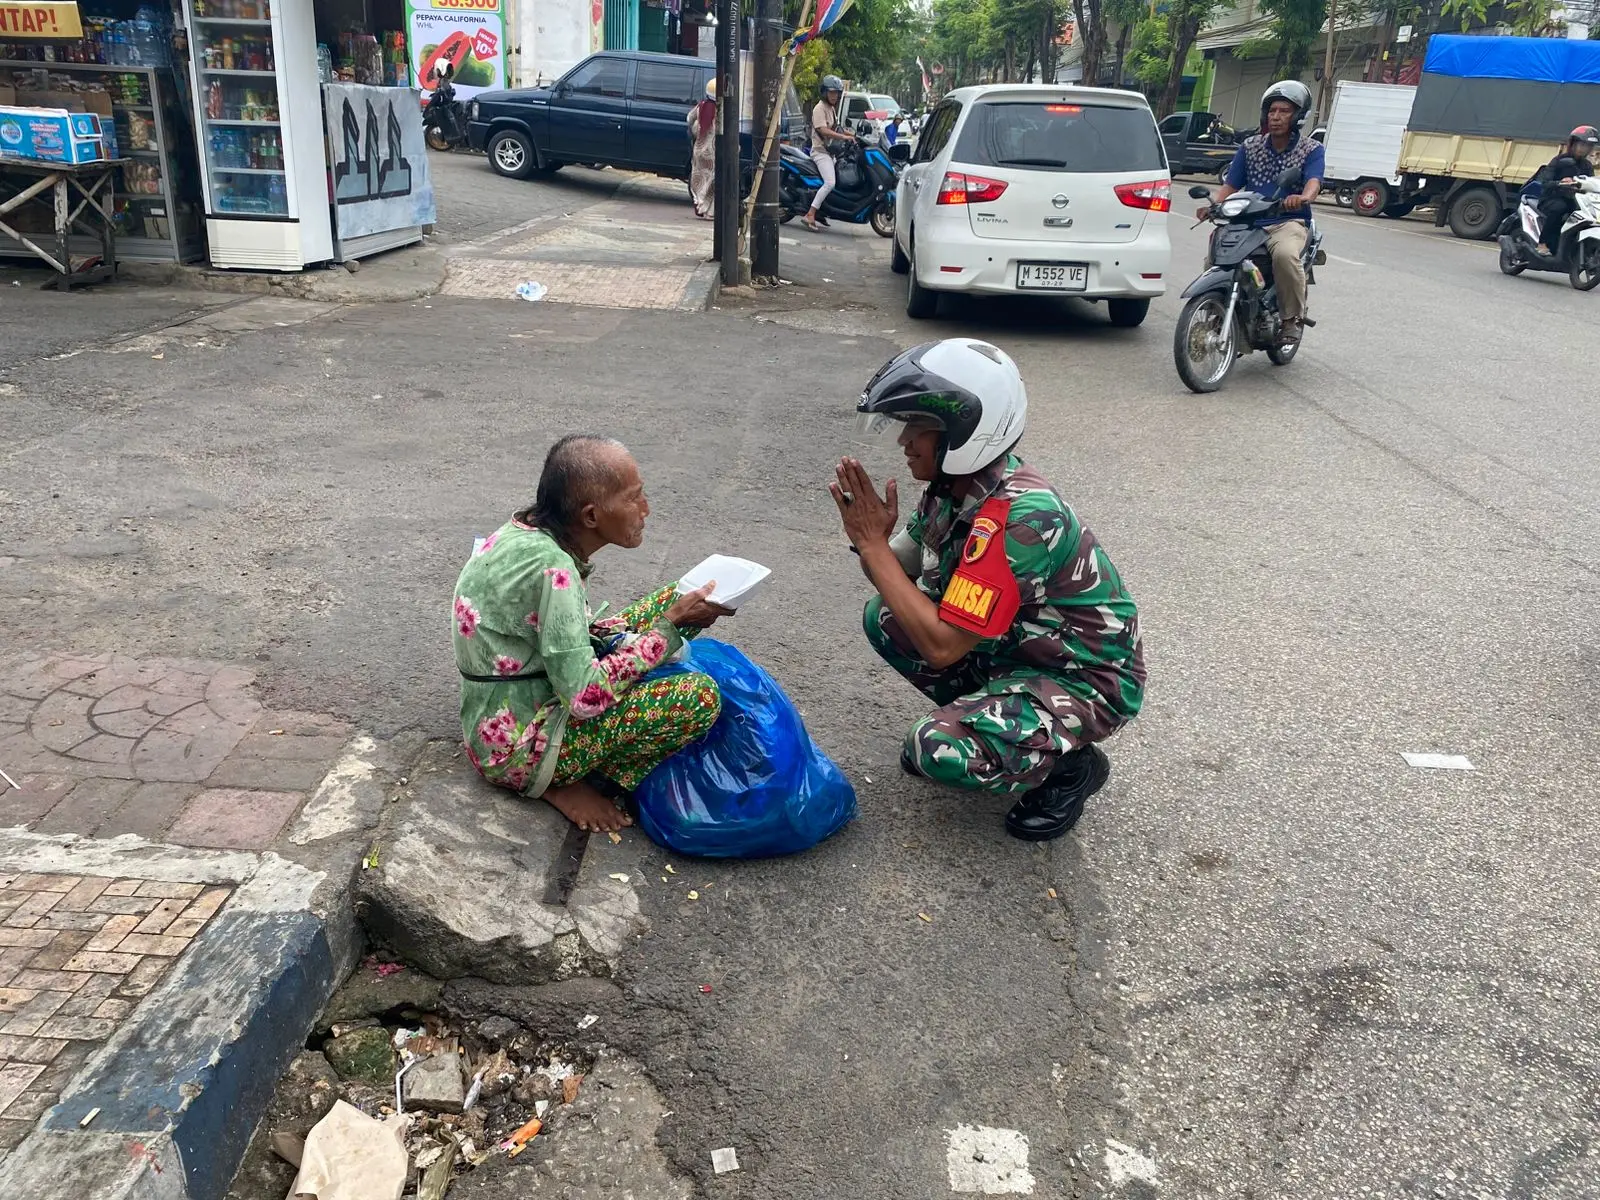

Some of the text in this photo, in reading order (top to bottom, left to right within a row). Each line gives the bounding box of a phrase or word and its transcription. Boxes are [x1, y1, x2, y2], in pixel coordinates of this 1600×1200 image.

[416, 14, 487, 23] PEPAYA CALIFORNIA
[475, 40, 493, 55] 10%
[1022, 266, 1083, 281] M 1552 VE
